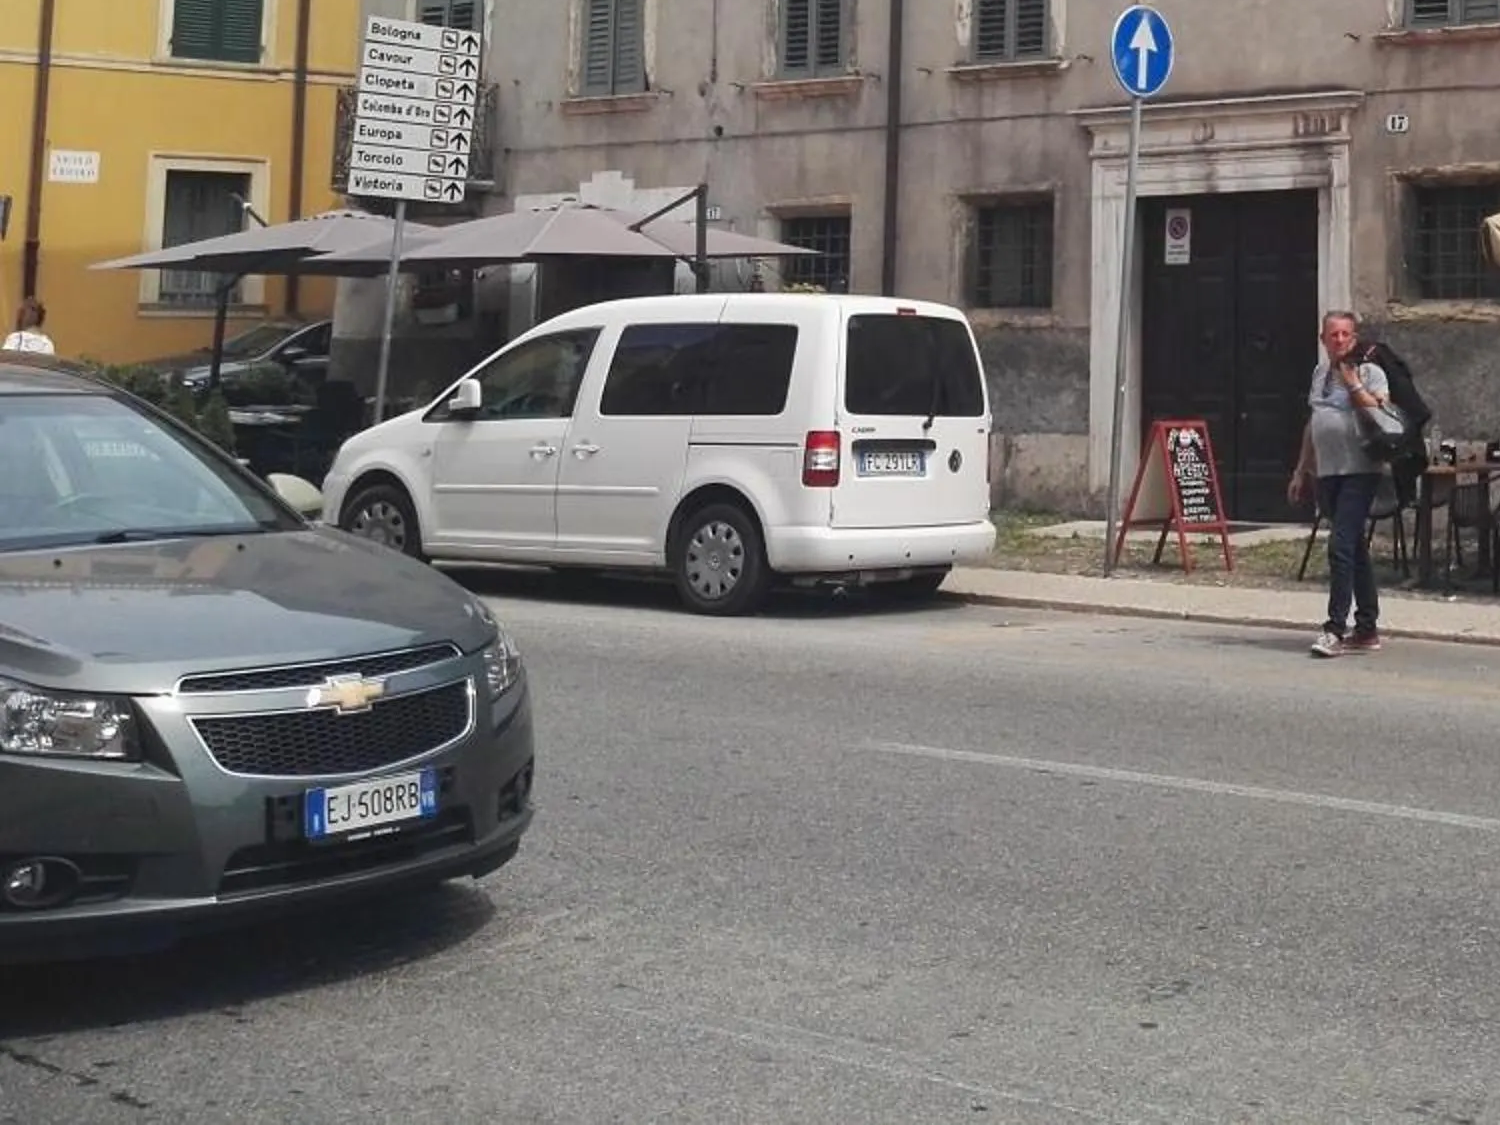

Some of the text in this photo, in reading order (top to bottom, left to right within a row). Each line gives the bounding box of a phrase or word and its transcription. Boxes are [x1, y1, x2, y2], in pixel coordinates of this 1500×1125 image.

[371, 22, 421, 41] Bologna
[368, 48, 413, 65] Cavour
[361, 99, 431, 118] Colomba d'Oro
[1391, 116, 1405, 130] 17
[358, 124, 403, 141] Europa
[356, 150, 403, 167] Torcolo
[353, 175, 404, 192] Victoria
